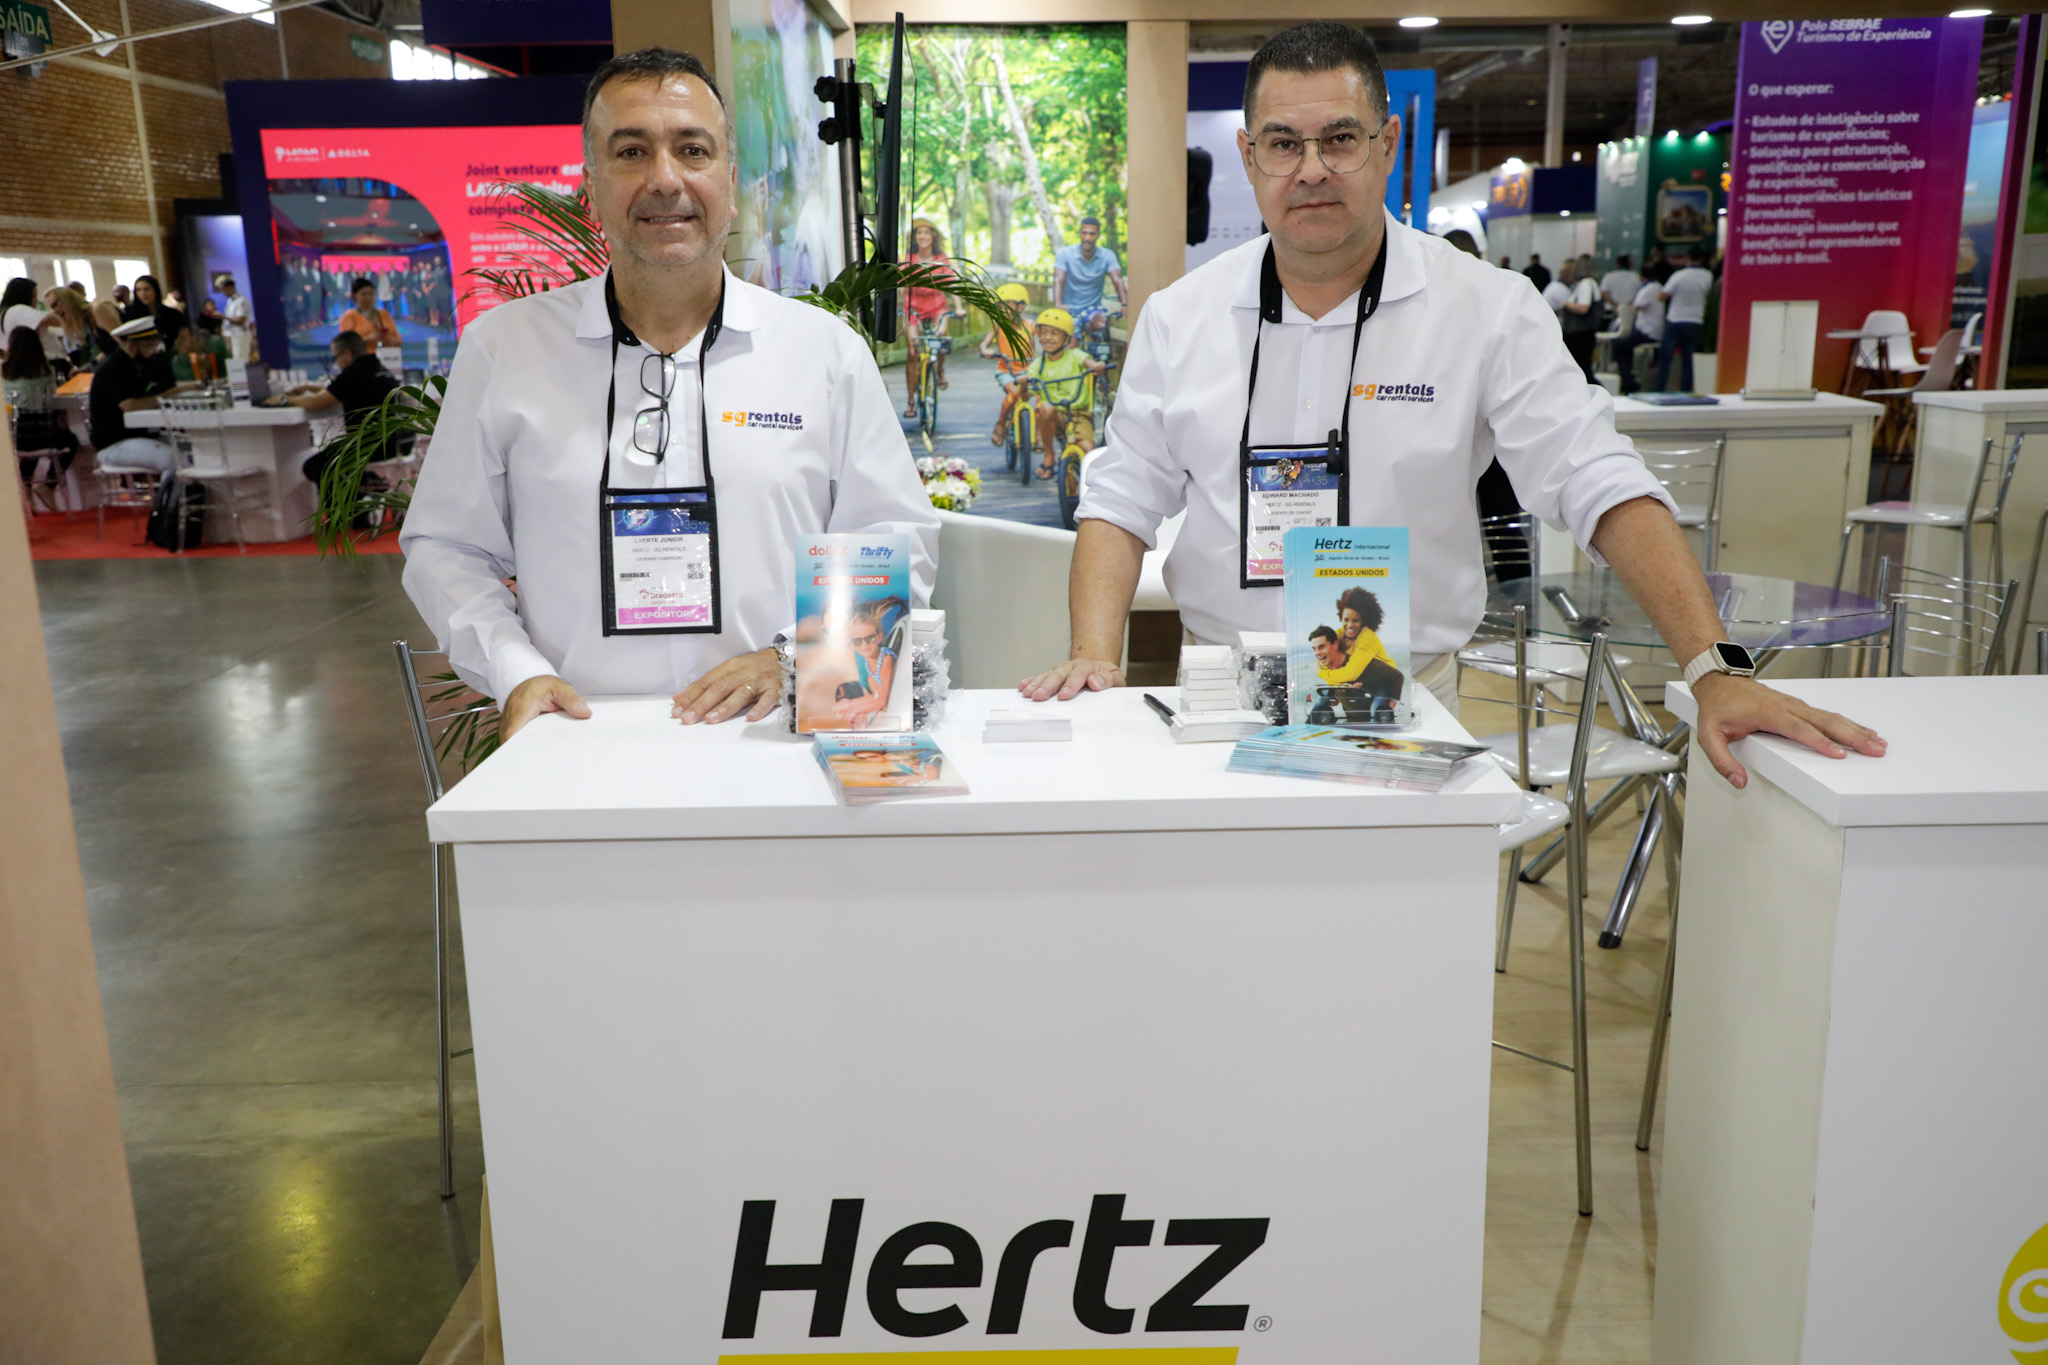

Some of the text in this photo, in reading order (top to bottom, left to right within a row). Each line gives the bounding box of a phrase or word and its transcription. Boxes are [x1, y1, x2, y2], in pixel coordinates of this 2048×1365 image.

[1829, 18, 1883, 31] SEBRAE
[1797, 28, 1932, 43] Turismo de Experiência
[1748, 84, 1759, 96] O
[1760, 86, 1783, 98] que
[1752, 111, 1920, 127] Estudos de inteligência sobre
[1751, 130, 1796, 143] turismo
[1798, 129, 1812, 141] de
[1750, 146, 1801, 159] Soluções
[1803, 147, 1830, 159] para
[466, 163, 500, 176] Joint
[504, 165, 559, 176] venture
[1747, 160, 1821, 175] qualificação
[1747, 178, 1762, 189] de
[1784, 190, 1856, 205] experiências
[1743, 221, 1900, 236] Metodologia inovadora que
[1740, 254, 1755, 265] de
[1408, 395, 1434, 403] services
[1314, 538, 1352, 550] Hertz
[860, 547, 895, 559] Thrifty
[634, 610, 690, 619] EXPOSITOR
[722, 1193, 1270, 1339] Hertz
